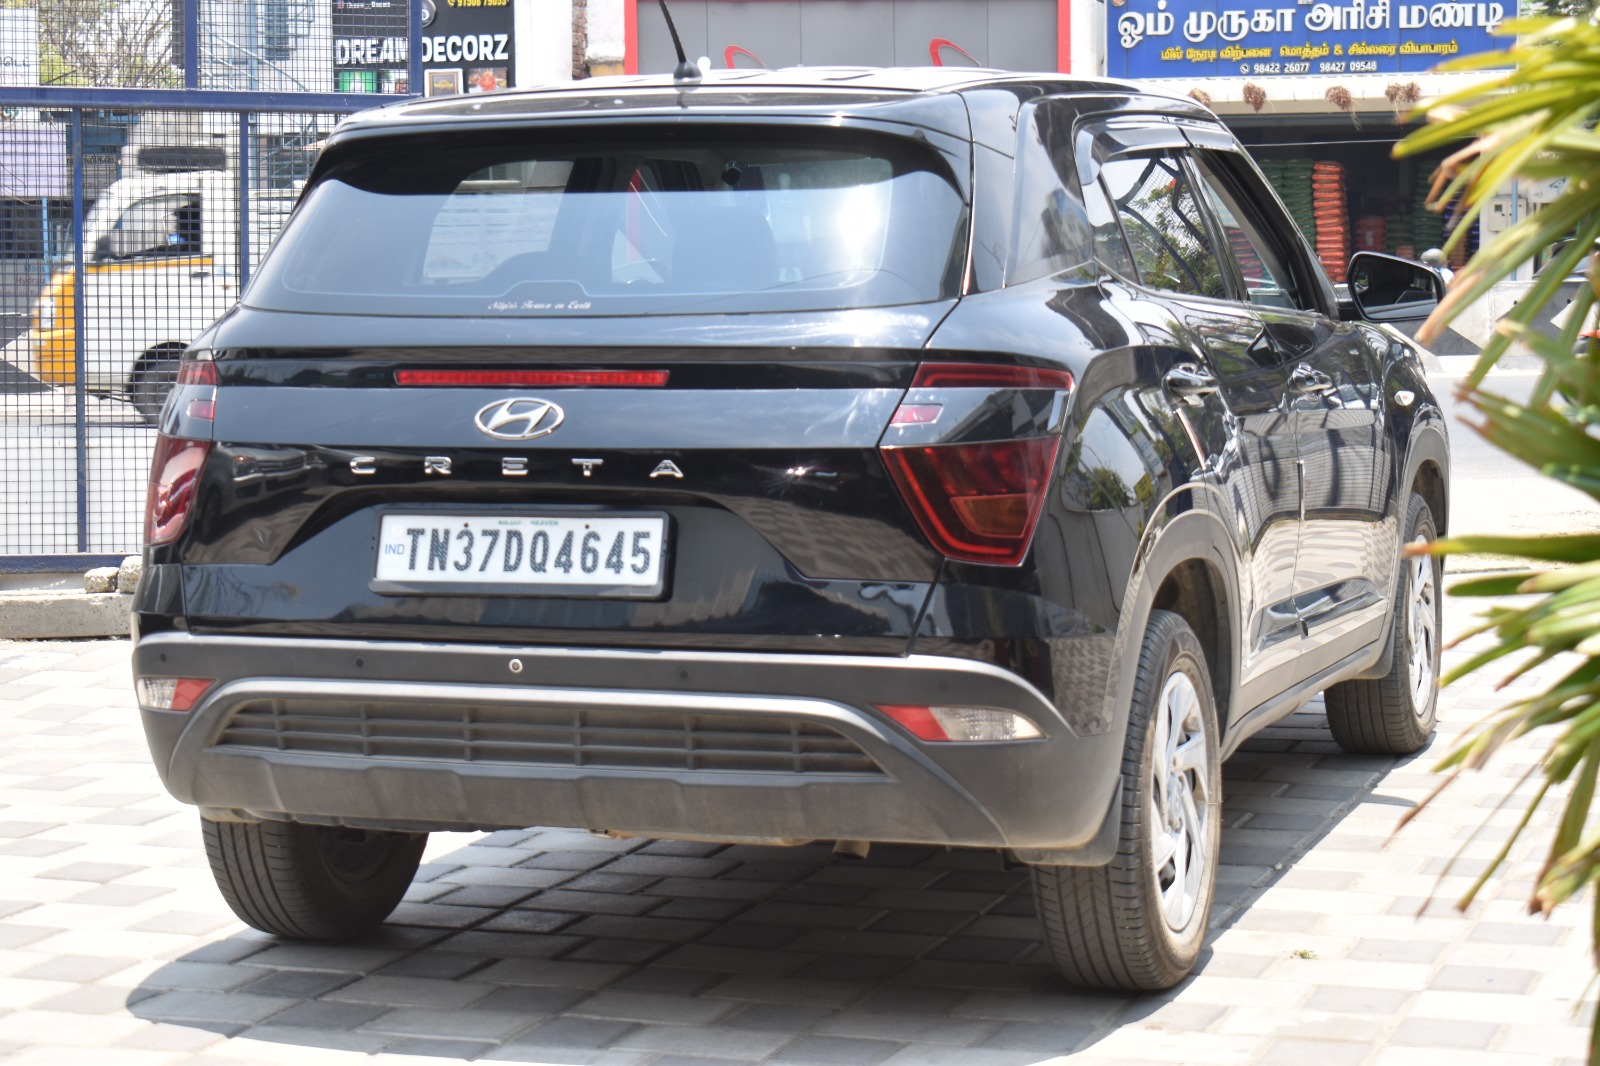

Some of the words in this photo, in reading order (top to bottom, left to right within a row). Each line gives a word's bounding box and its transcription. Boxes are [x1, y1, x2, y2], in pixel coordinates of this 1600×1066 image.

[1117, 0, 1174, 48] ஓம்
[1183, 8, 1296, 42] முருகா
[1304, 0, 1391, 31] அரிசி
[1398, 0, 1504, 34] மண்டி
[421, 34, 509, 63] DECORZ
[1333, 44, 1344, 57] &
[1253, 63, 1281, 74] 98422
[1283, 62, 1311, 74] 26077
[1319, 61, 1346, 73] 98427
[1349, 61, 1378, 72] 09548
[349, 456, 685, 478] CRETA
[384, 544, 406, 557] IND
[405, 527, 652, 575] TN37DQ4645
